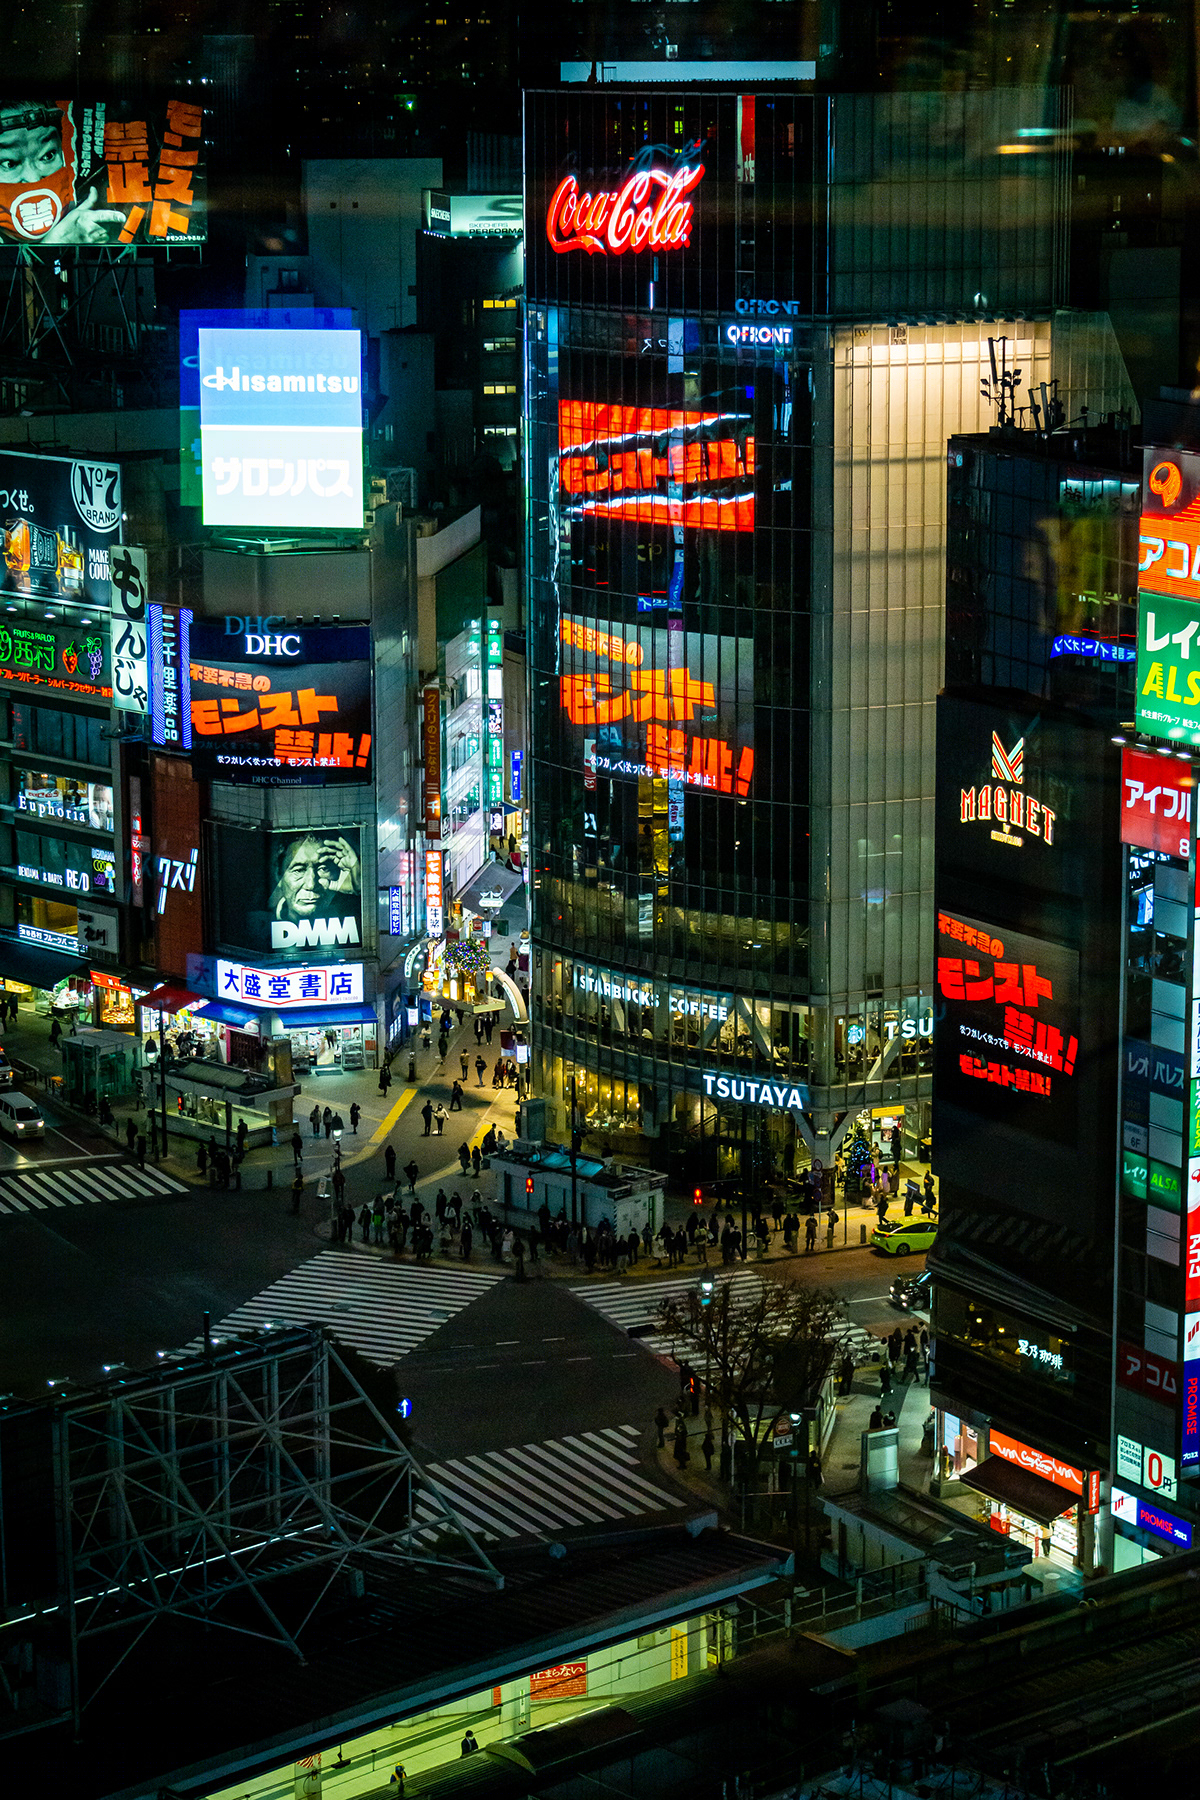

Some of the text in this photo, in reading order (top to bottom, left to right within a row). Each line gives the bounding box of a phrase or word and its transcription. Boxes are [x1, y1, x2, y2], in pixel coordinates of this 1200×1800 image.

[547, 163, 703, 256] Coca-Cola
[727, 325, 792, 345] QFRONT
[203, 366, 359, 393] Hisamitsu
[211, 457, 353, 497] サロンパス
[86, 509, 116, 524] BRAND
[89, 549, 110, 564] MAKE
[113, 549, 147, 710] もんじゃ
[246, 635, 300, 656] DHC
[1146, 612, 1200, 660] レイ
[162, 614, 180, 742] 三千里薬品
[190, 662, 271, 693] 不要不急の
[191, 688, 339, 736] モンスト
[560, 667, 716, 725] モンスト
[427, 694, 438, 776] クスリのことなら
[217, 755, 282, 768] なつかしくなっても
[252, 775, 302, 785] DHC Channel
[18, 791, 86, 822] Euphoria
[960, 785, 1056, 846] MAGNET
[1125, 778, 1191, 823] アイフル
[271, 916, 359, 949] DMM
[938, 912, 1005, 959] 不要不急の
[224, 968, 353, 999] 大盛堂書店
[579, 974, 728, 1021] STARBUCKS COFFEE
[938, 957, 1054, 1008] モンスト
[884, 1017, 933, 1041] TSU
[960, 1025, 1010, 1050] なつかしくなっても
[702, 1074, 804, 1110] TSUTAYA
[1131, 1137, 1141, 1149] 6F
[1124, 1161, 1178, 1193] レイク ALSA
[1018, 1339, 1064, 1370] 星乃珈琲
[1126, 1355, 1177, 1394] アコム
[1186, 1377, 1198, 1435] PROMISE
[1140, 1509, 1174, 1535] PROMISE
